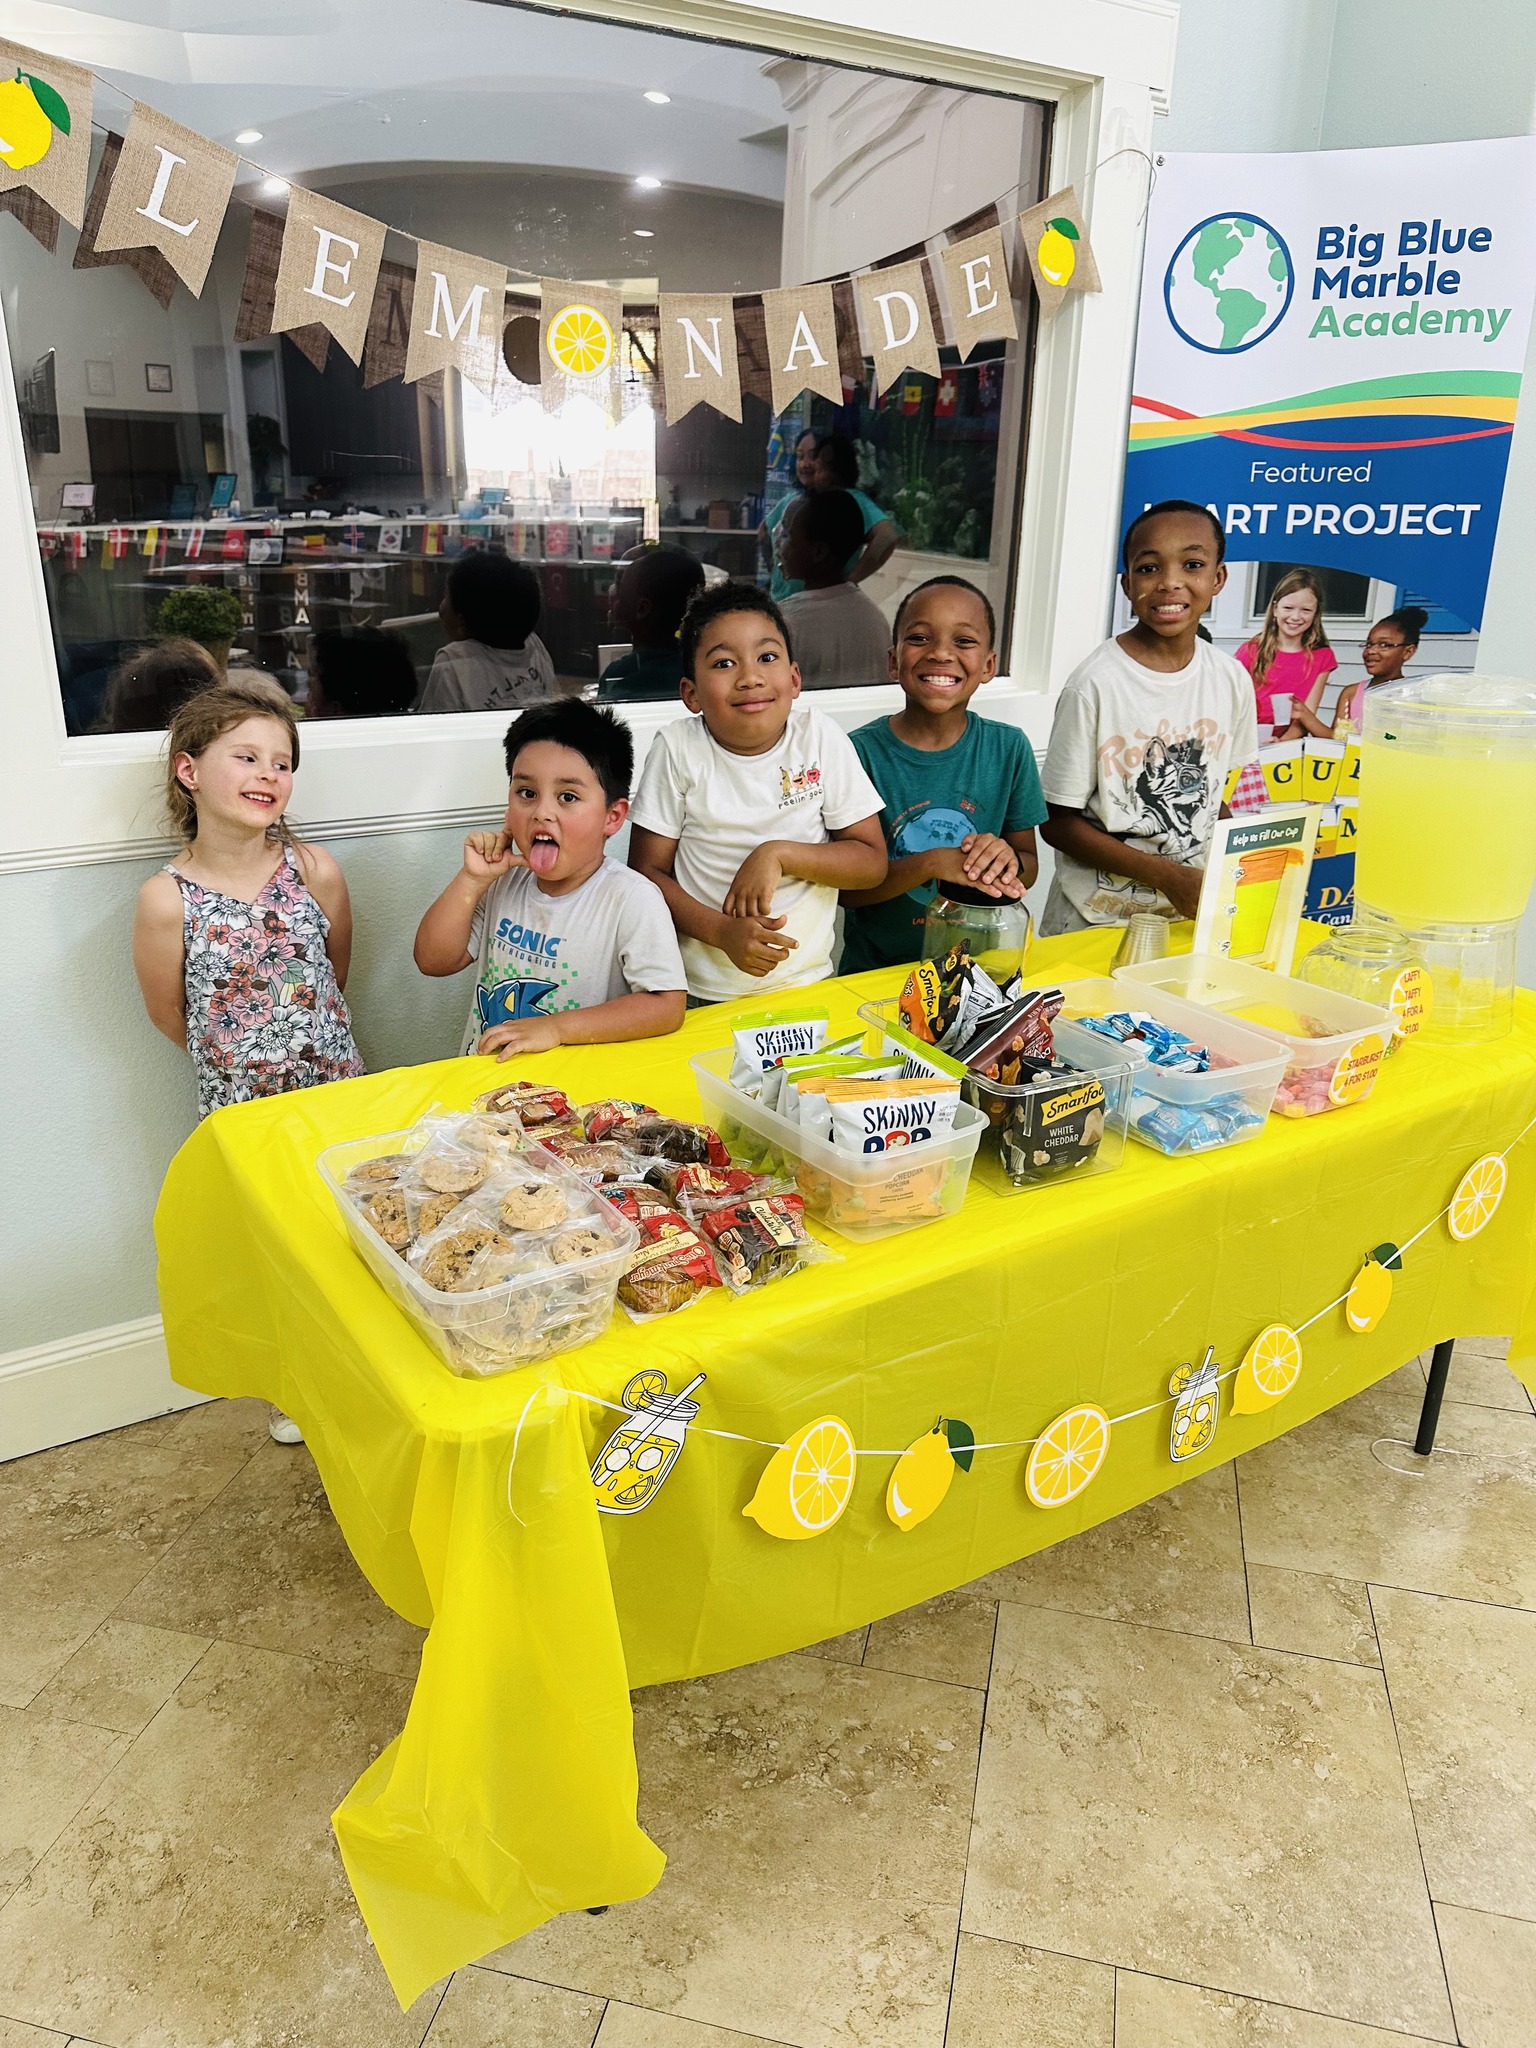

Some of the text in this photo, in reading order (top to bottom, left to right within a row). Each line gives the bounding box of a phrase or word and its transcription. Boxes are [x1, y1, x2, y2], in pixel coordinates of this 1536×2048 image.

[1315, 219, 1493, 268] Big Blue
[1311, 260, 1461, 300] Marble
[1308, 301, 1512, 343] Academy
[1249, 460, 1372, 484] Featured
[1285, 503, 1481, 536] PROJECT
[1232, 832, 1249, 847] Help
[1258, 829, 1270, 842] Fill
[1270, 829, 1284, 840] Our
[1284, 827, 1299, 839] Cup
[495, 917, 562, 958] SONIC
[1403, 969, 1421, 983] LAFFY
[1404, 987, 1421, 1001] TAFFY
[1406, 1005, 1418, 1016] FOR
[1347, 1050, 1384, 1070] STARBURST
[1348, 1073, 1362, 1086] FOR
[1044, 1133, 1080, 1148] CHEDDAR
[1049, 1124, 1075, 1138] WHITE
